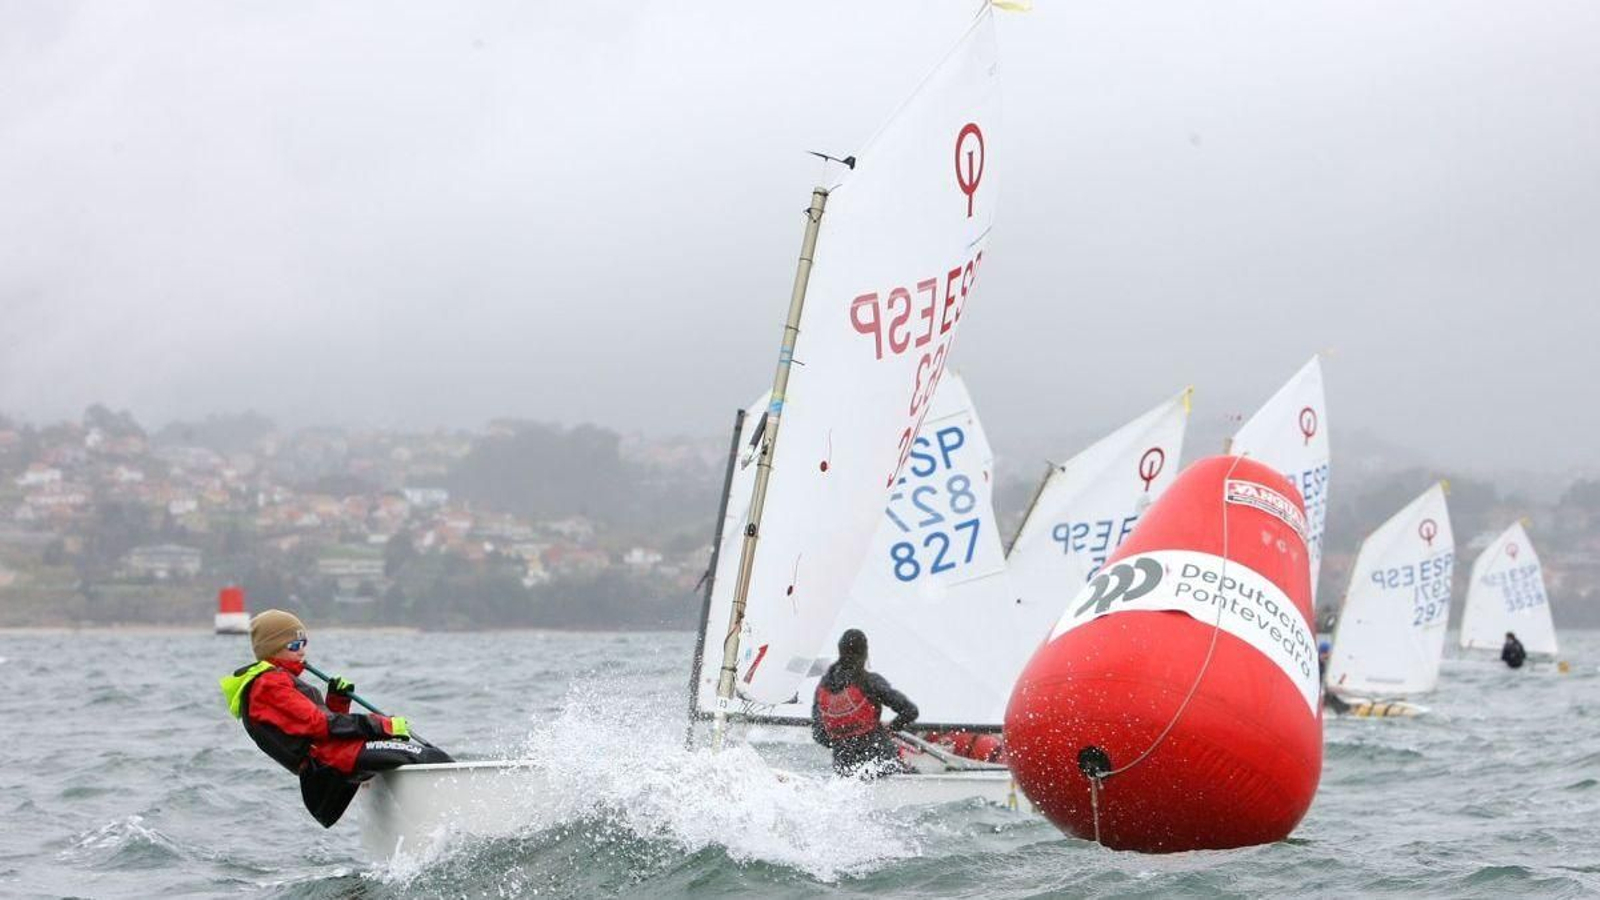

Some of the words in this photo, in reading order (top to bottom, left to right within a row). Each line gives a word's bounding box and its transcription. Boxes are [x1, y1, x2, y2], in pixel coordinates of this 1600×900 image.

[904, 426, 965, 481] SP
[890, 518, 980, 582] 827
[1175, 582, 1311, 679] Pontevedra
[1181, 563, 1313, 661] Deputación
